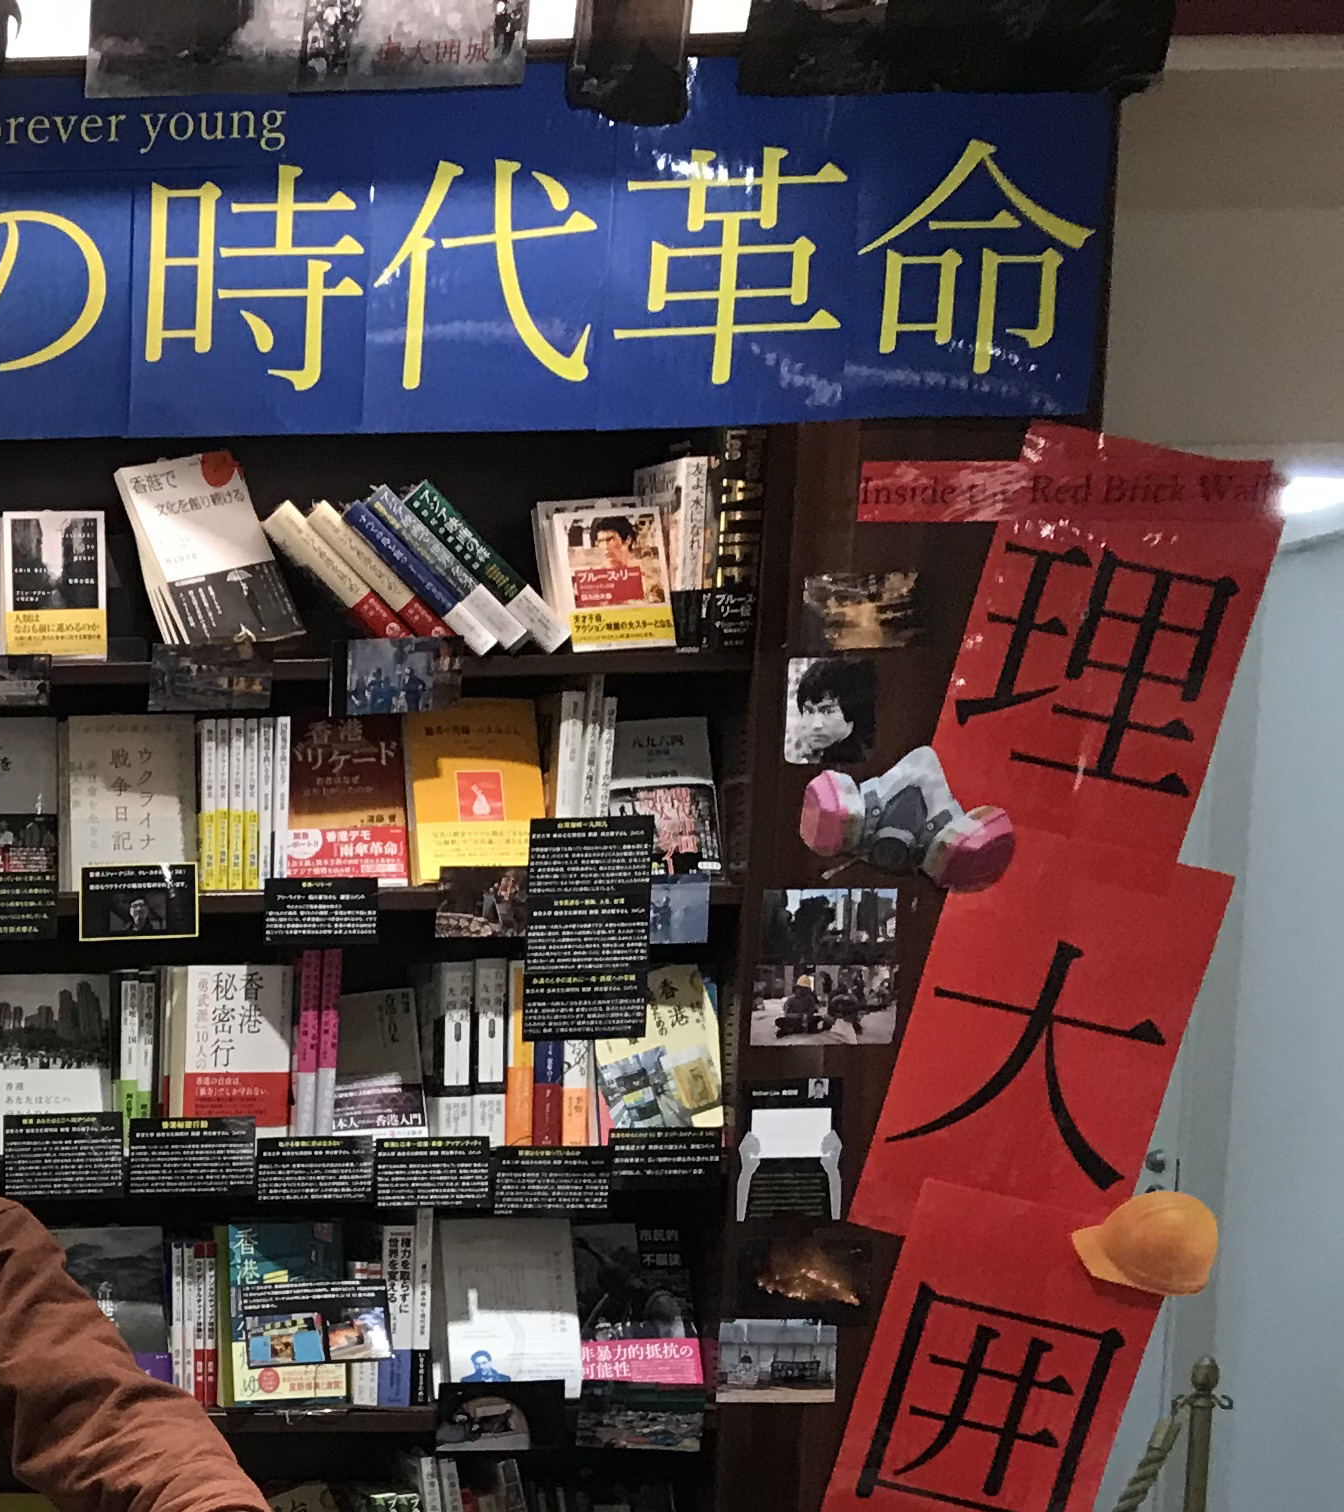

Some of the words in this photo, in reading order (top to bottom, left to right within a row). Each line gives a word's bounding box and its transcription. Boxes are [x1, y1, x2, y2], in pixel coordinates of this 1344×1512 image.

[139, 108, 287, 153] young
[129, 470, 179, 495] 香港で
[1030, 475, 1091, 505] Red
[304, 718, 364, 742] 香港
[112, 747, 133, 853] 戦争日記
[136, 747, 156, 853] ウクライナ
[238, 970, 264, 1036] 香港
[233, 1226, 260, 1286] 香港
[387, 1236, 400, 1303] 世界を変える
[399, 1236, 411, 1315] 権力を取らずに
